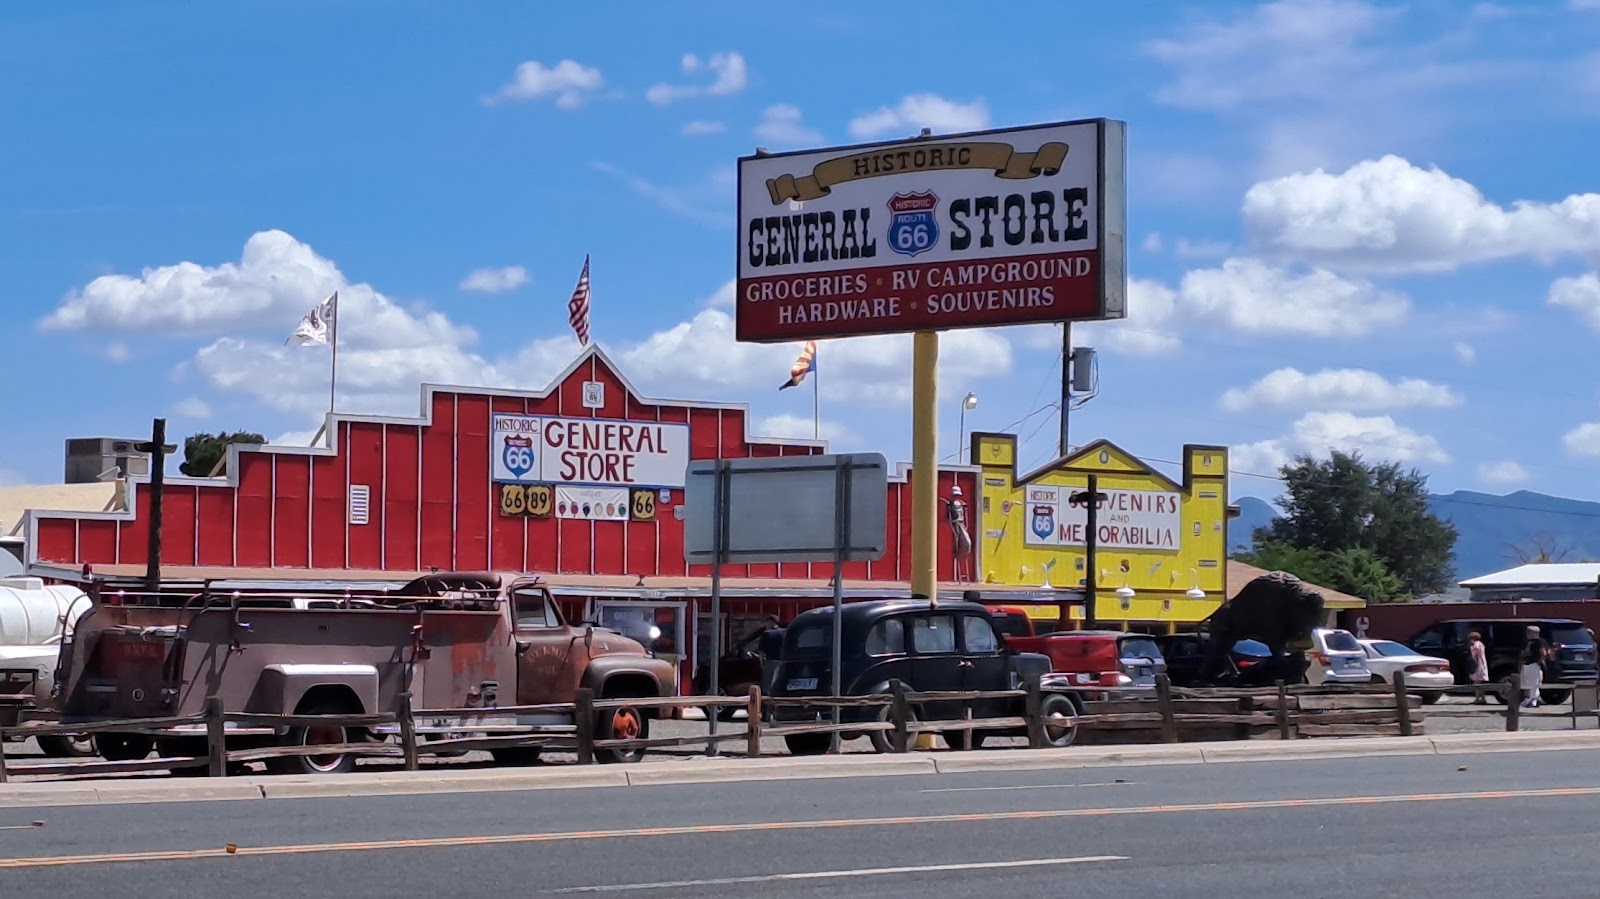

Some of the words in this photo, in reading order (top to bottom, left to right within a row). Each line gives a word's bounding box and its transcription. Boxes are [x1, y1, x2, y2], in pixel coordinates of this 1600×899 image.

[853, 147, 971, 177] HISTORIC
[748, 207, 877, 268] GENERAL
[949, 187, 1088, 251] STORE
[897, 223, 929, 249] 66
[746, 274, 867, 302] GROCERIES
[892, 269, 921, 291] RV
[926, 256, 1091, 288] CAMPGROUND
[778, 296, 901, 325] HARDWARE
[926, 285, 1055, 314] SOUVENIRS
[495, 418, 538, 433] HISTORIC
[544, 420, 668, 454] GENERAL
[506, 446, 531, 470] 66
[559, 450, 636, 483] STORE
[504, 490, 523, 509] 66
[531, 491, 548, 510] 89
[635, 495, 654, 514] 66
[1070, 490, 1177, 514] SVENIRS
[1035, 515, 1050, 532] 66
[1109, 514, 1130, 524] AND
[1059, 523, 1173, 547] MEORABILIA
